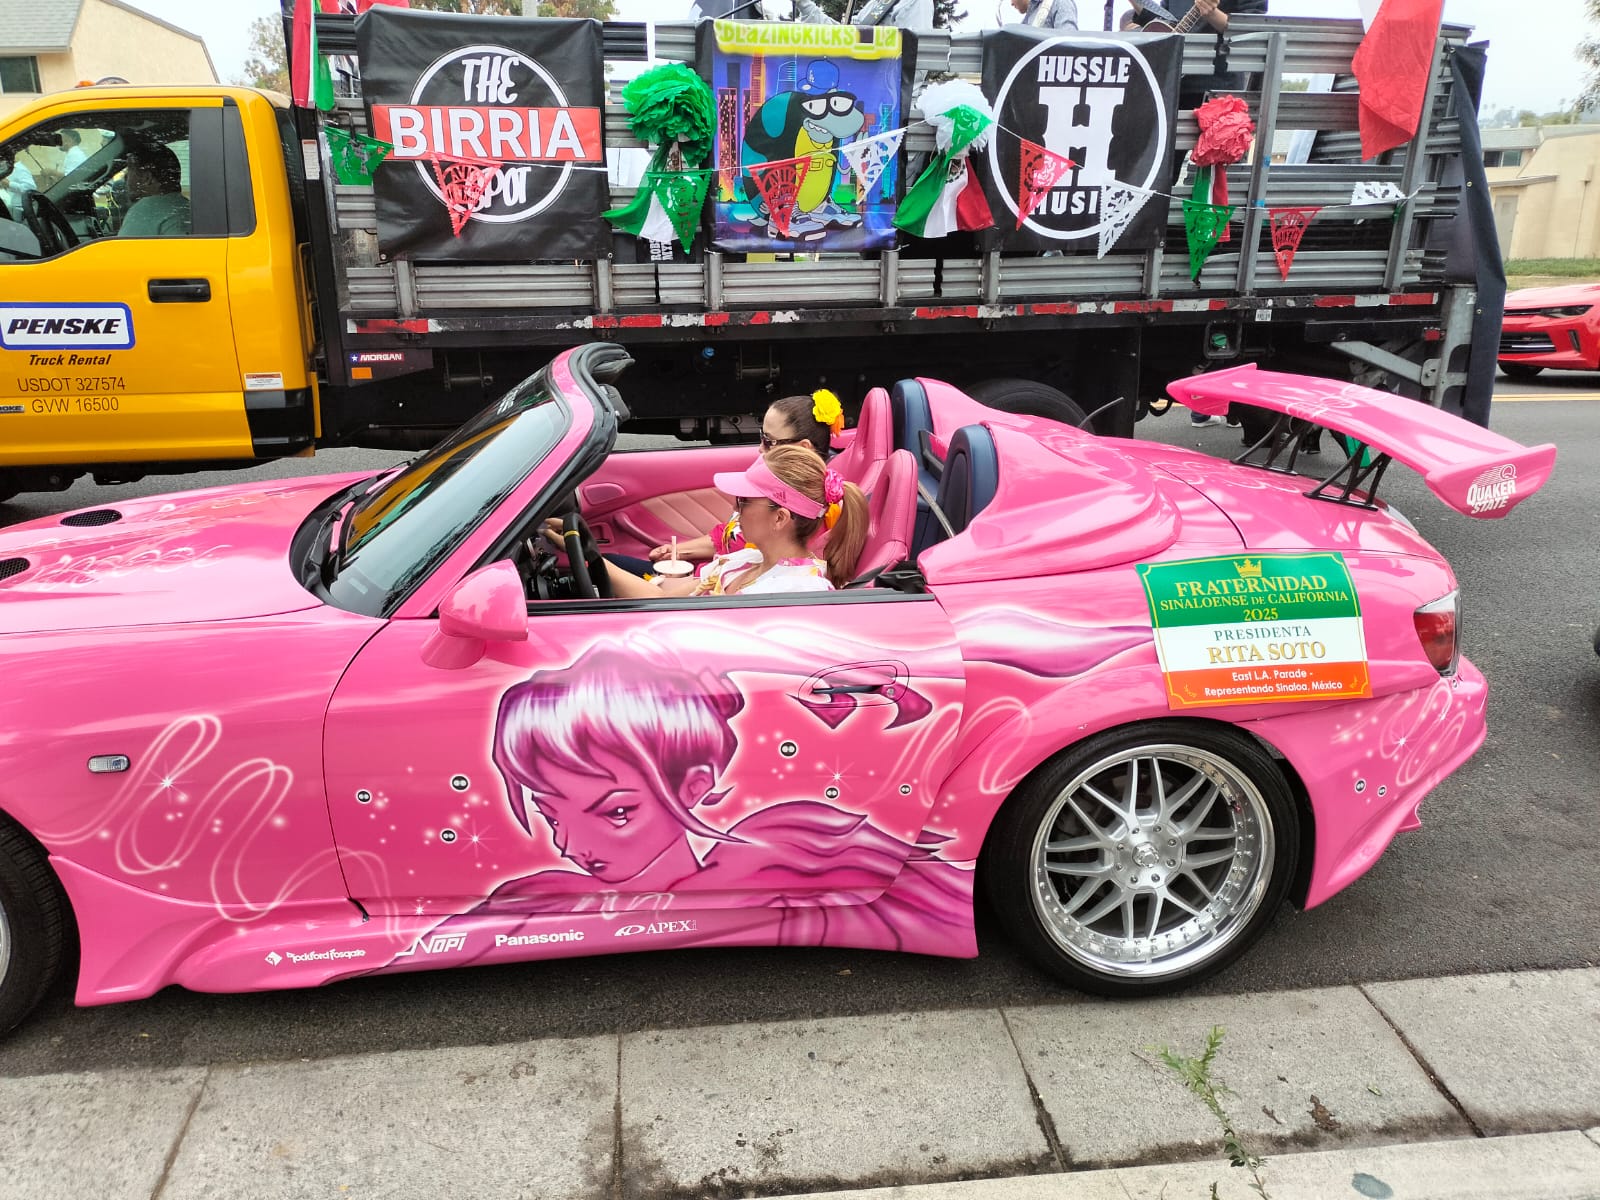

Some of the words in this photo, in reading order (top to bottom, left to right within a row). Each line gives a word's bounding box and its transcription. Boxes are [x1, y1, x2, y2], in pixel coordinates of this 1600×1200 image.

[1037, 56, 1131, 83] HUSSLE
[462, 56, 519, 104] THE
[388, 107, 586, 158] BIRRIA
[1038, 87, 1126, 187] H
[1028, 190, 1099, 215] MUSI
[8, 318, 121, 334] PENSKE
[29, 354, 64, 365] Truck
[68, 354, 112, 365] Rental
[360, 353, 402, 361] MORGAN
[17, 377, 72, 392] USDOT
[76, 377, 125, 391] 327574
[32, 398, 70, 413] GVW
[76, 397, 119, 412] 16500
[1466, 479, 1516, 507] QUAKER
[1470, 496, 1510, 514] STATE
[1174, 575, 1328, 597] FRATERNIDAD
[1160, 594, 1249, 611] SINALOENSE
[1251, 596, 1265, 605] DE
[1267, 591, 1349, 605] CALIFORNIA
[1243, 608, 1279, 622] 2025
[1214, 625, 1312, 641] PRESIDENTA
[1206, 644, 1264, 664] RITA
[1268, 641, 1326, 661] SOTO
[1232, 671, 1252, 681] East
[1254, 670, 1272, 681] L.A.
[1274, 669, 1307, 679] Parade
[1205, 683, 1274, 697] Representando
[1312, 680, 1343, 691] México
[395, 932, 468, 957] NOPI
[495, 928, 585, 947] Panasonic
[286, 950, 330, 964] Rockford
[329, 948, 366, 961] Fosgate
